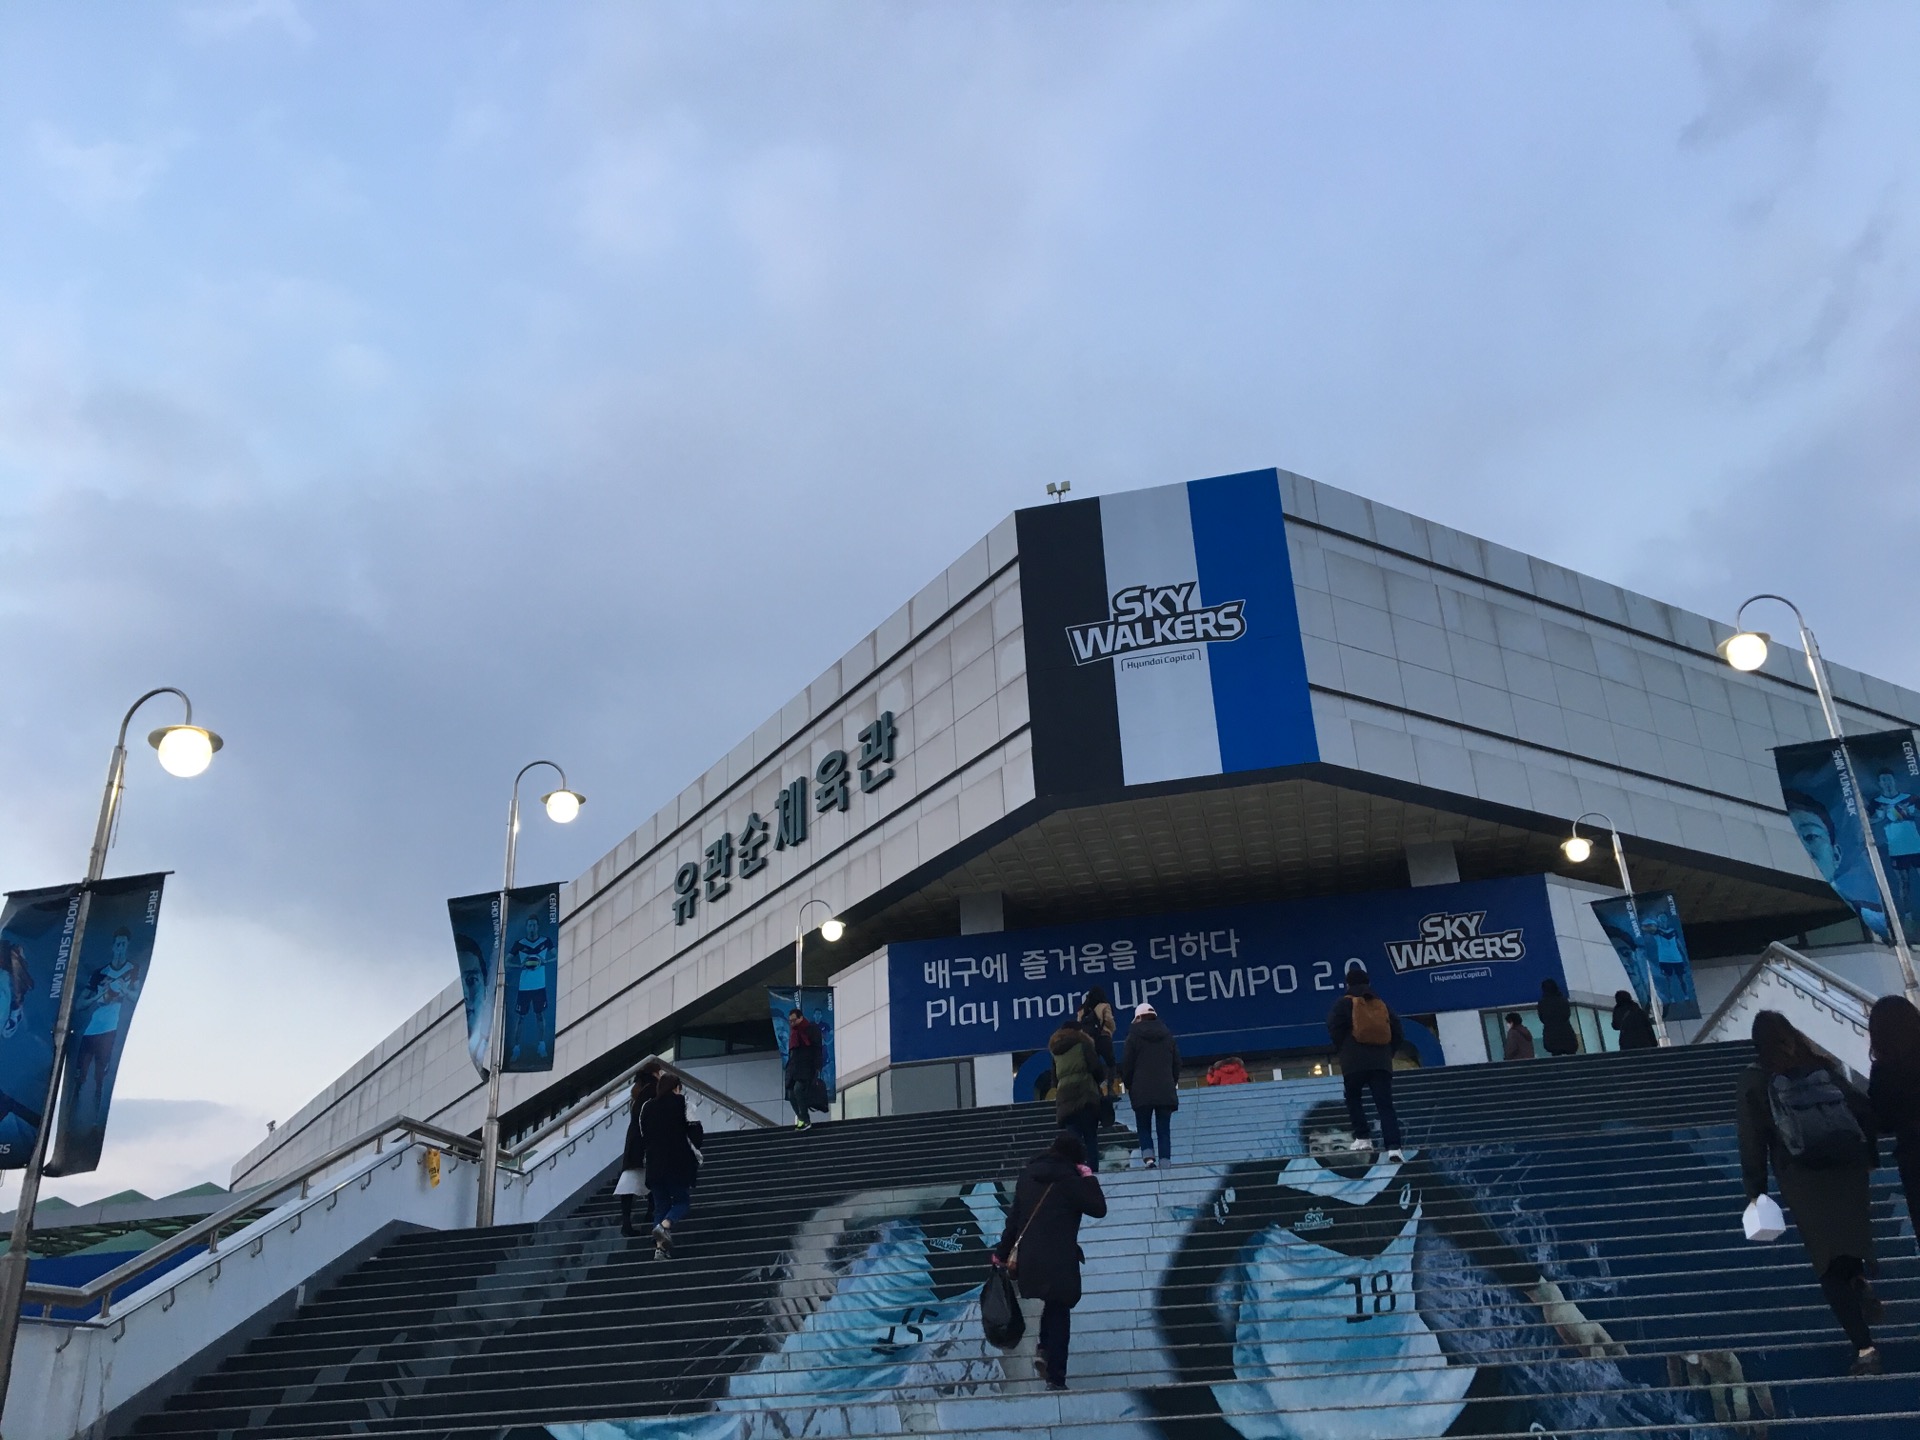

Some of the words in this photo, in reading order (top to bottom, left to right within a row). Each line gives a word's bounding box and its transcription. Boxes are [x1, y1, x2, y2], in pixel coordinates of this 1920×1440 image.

[1116, 588, 1192, 621] SKY
[1072, 606, 1238, 660] WALKERS
[1126, 658, 1163, 670] Hyundai
[1164, 652, 1196, 664] Capital
[1902, 741, 1919, 776] CENTER
[671, 710, 897, 926] 유관순체육관
[63, 896, 80, 934] MOON
[145, 890, 158, 925] RIGHT
[549, 892, 557, 924] CENTER
[1423, 915, 1480, 942] SKY
[55, 936, 71, 971] SUNG
[924, 952, 1009, 989] 배구에
[1019, 939, 1138, 981] 즐거움을
[1149, 927, 1241, 965] 더하다
[1389, 932, 1521, 970] WALKERS
[49, 973, 64, 999] MIN
[1434, 973, 1463, 982] Hyundai
[1463, 970, 1487, 979] Capital
[926, 996, 999, 1032] Play
[1113, 963, 1299, 1011] UPTEMPO
[1346, 1270, 1396, 1323] 18
